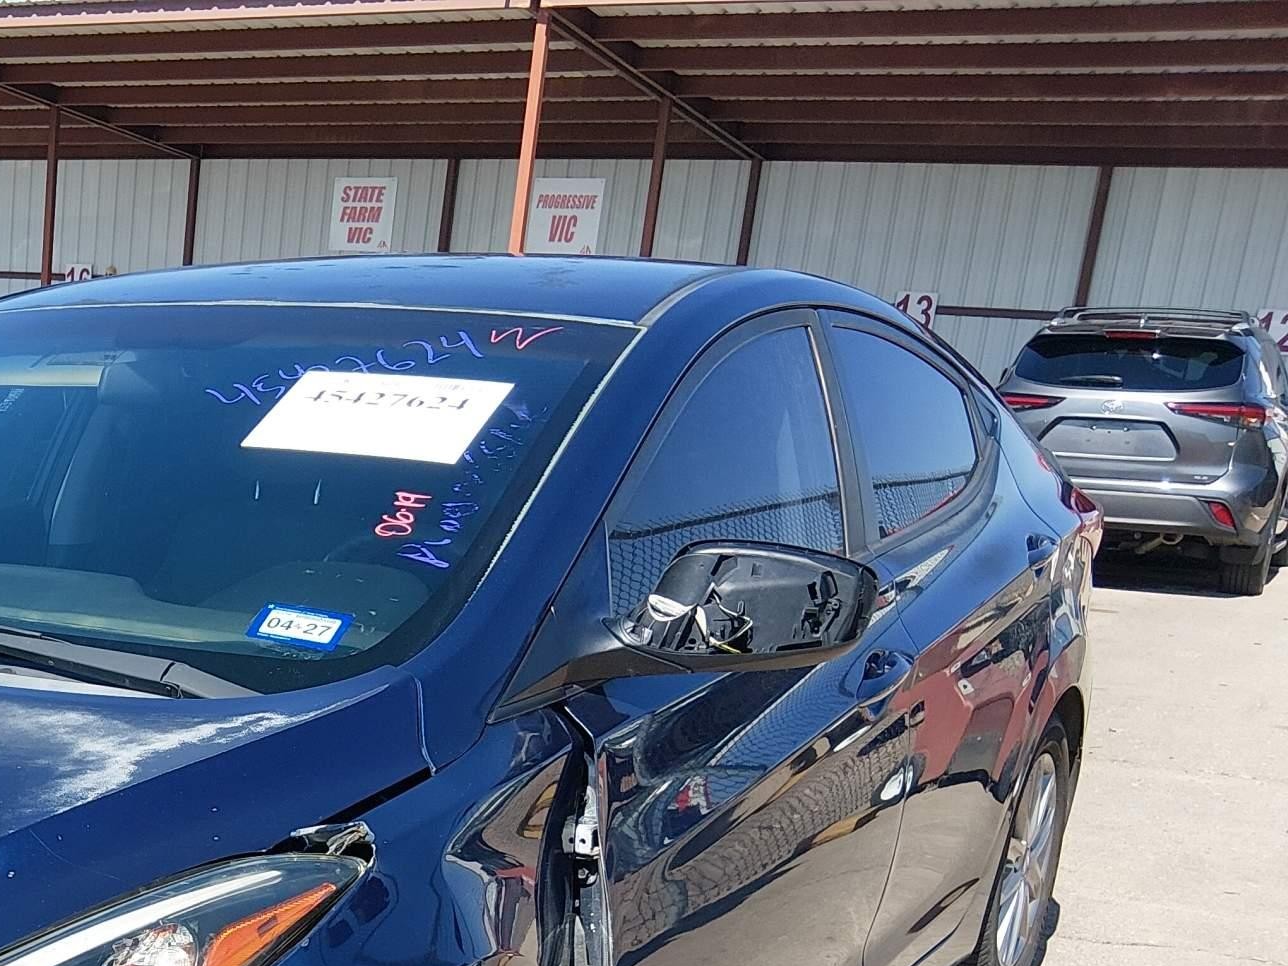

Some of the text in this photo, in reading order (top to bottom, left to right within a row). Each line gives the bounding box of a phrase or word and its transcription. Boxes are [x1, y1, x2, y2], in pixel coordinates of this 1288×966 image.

[340, 185, 387, 203] STATE
[536, 193, 598, 209] PROGRESSIVE
[339, 206, 383, 223] FARM
[346, 226, 373, 244] VIC
[548, 214, 578, 243] VIC
[304, 389, 472, 411] 45427624
